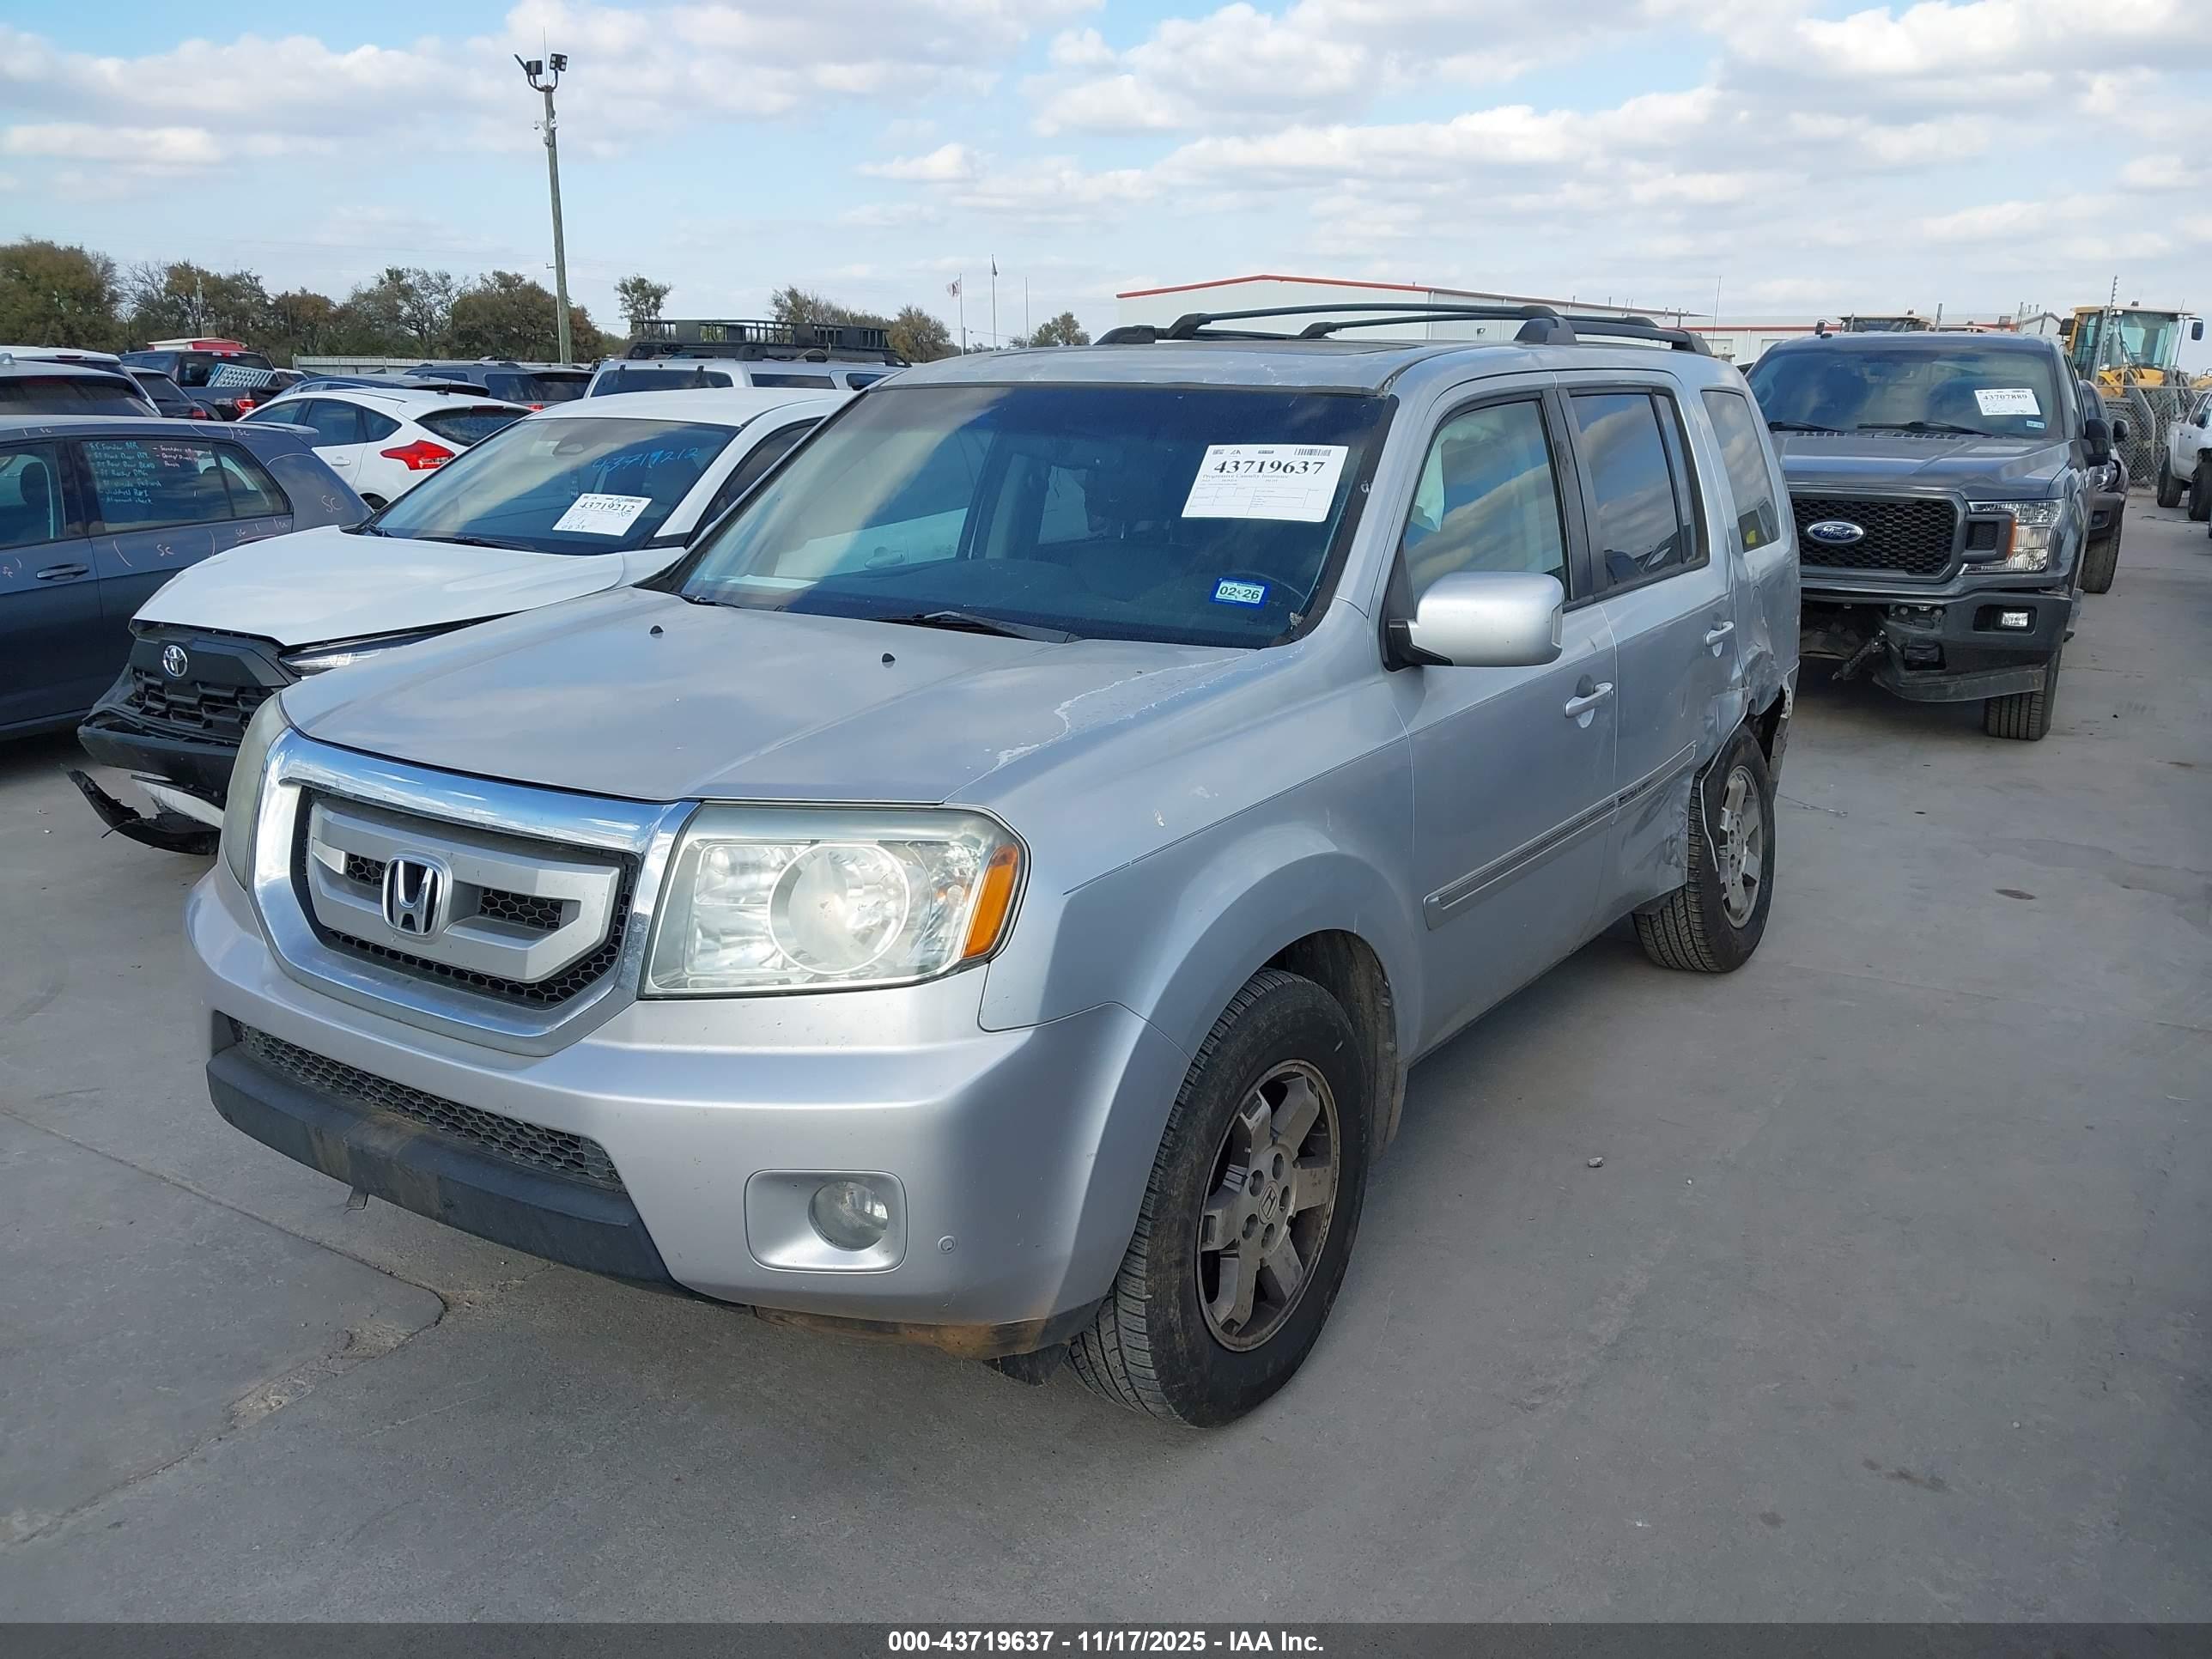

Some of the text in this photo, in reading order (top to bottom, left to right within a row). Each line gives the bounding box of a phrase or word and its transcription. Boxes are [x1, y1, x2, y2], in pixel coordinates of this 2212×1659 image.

[1214, 459, 1326, 475] 43719637
[580, 501, 635, 513] 43719212
[1820, 525, 1850, 538] Ford
